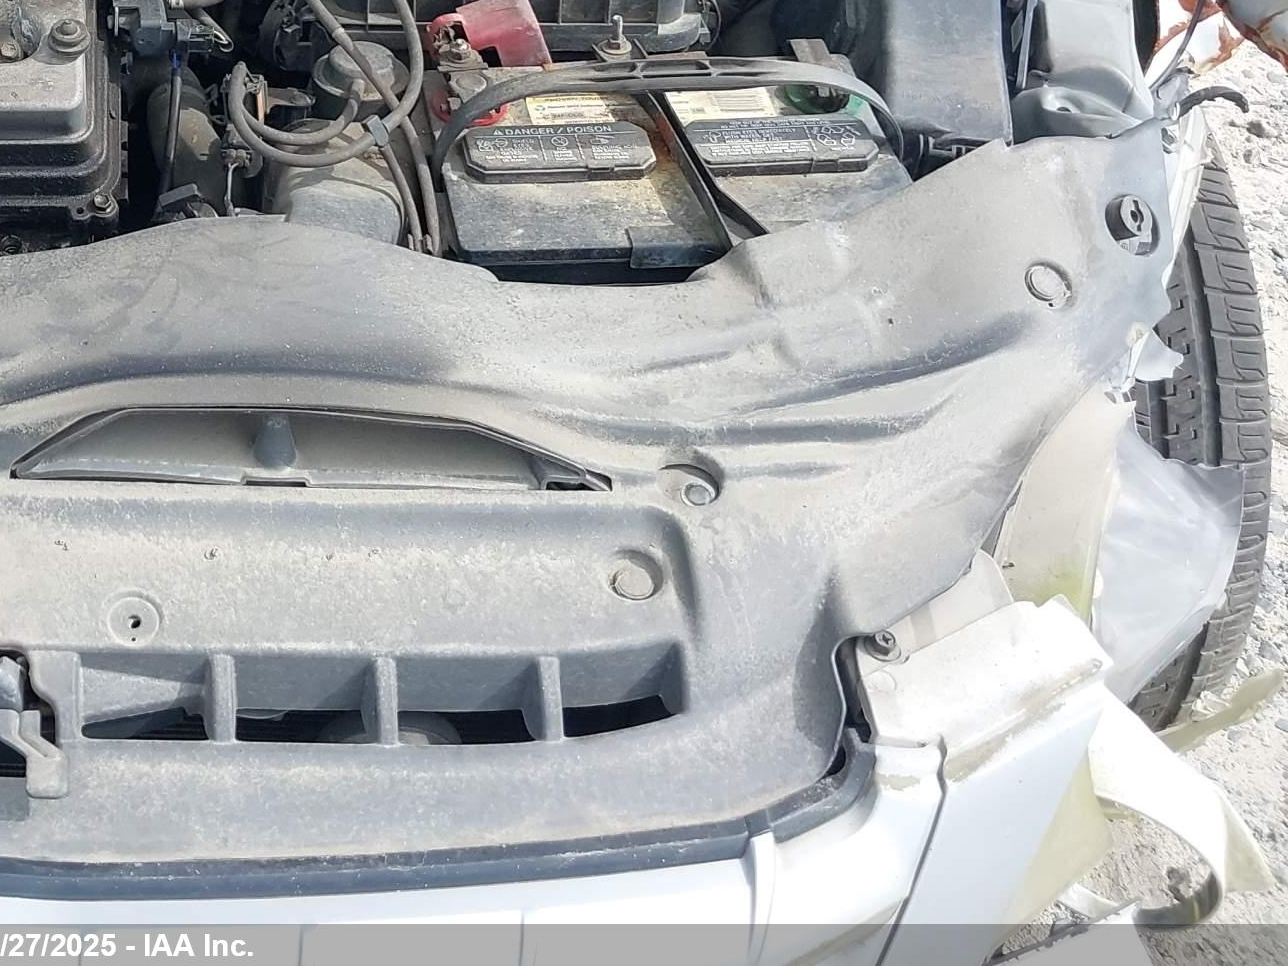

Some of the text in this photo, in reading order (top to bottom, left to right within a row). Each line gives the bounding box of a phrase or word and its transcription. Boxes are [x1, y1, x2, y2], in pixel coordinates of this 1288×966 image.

[505, 125, 613, 136] DANGER / POISON
